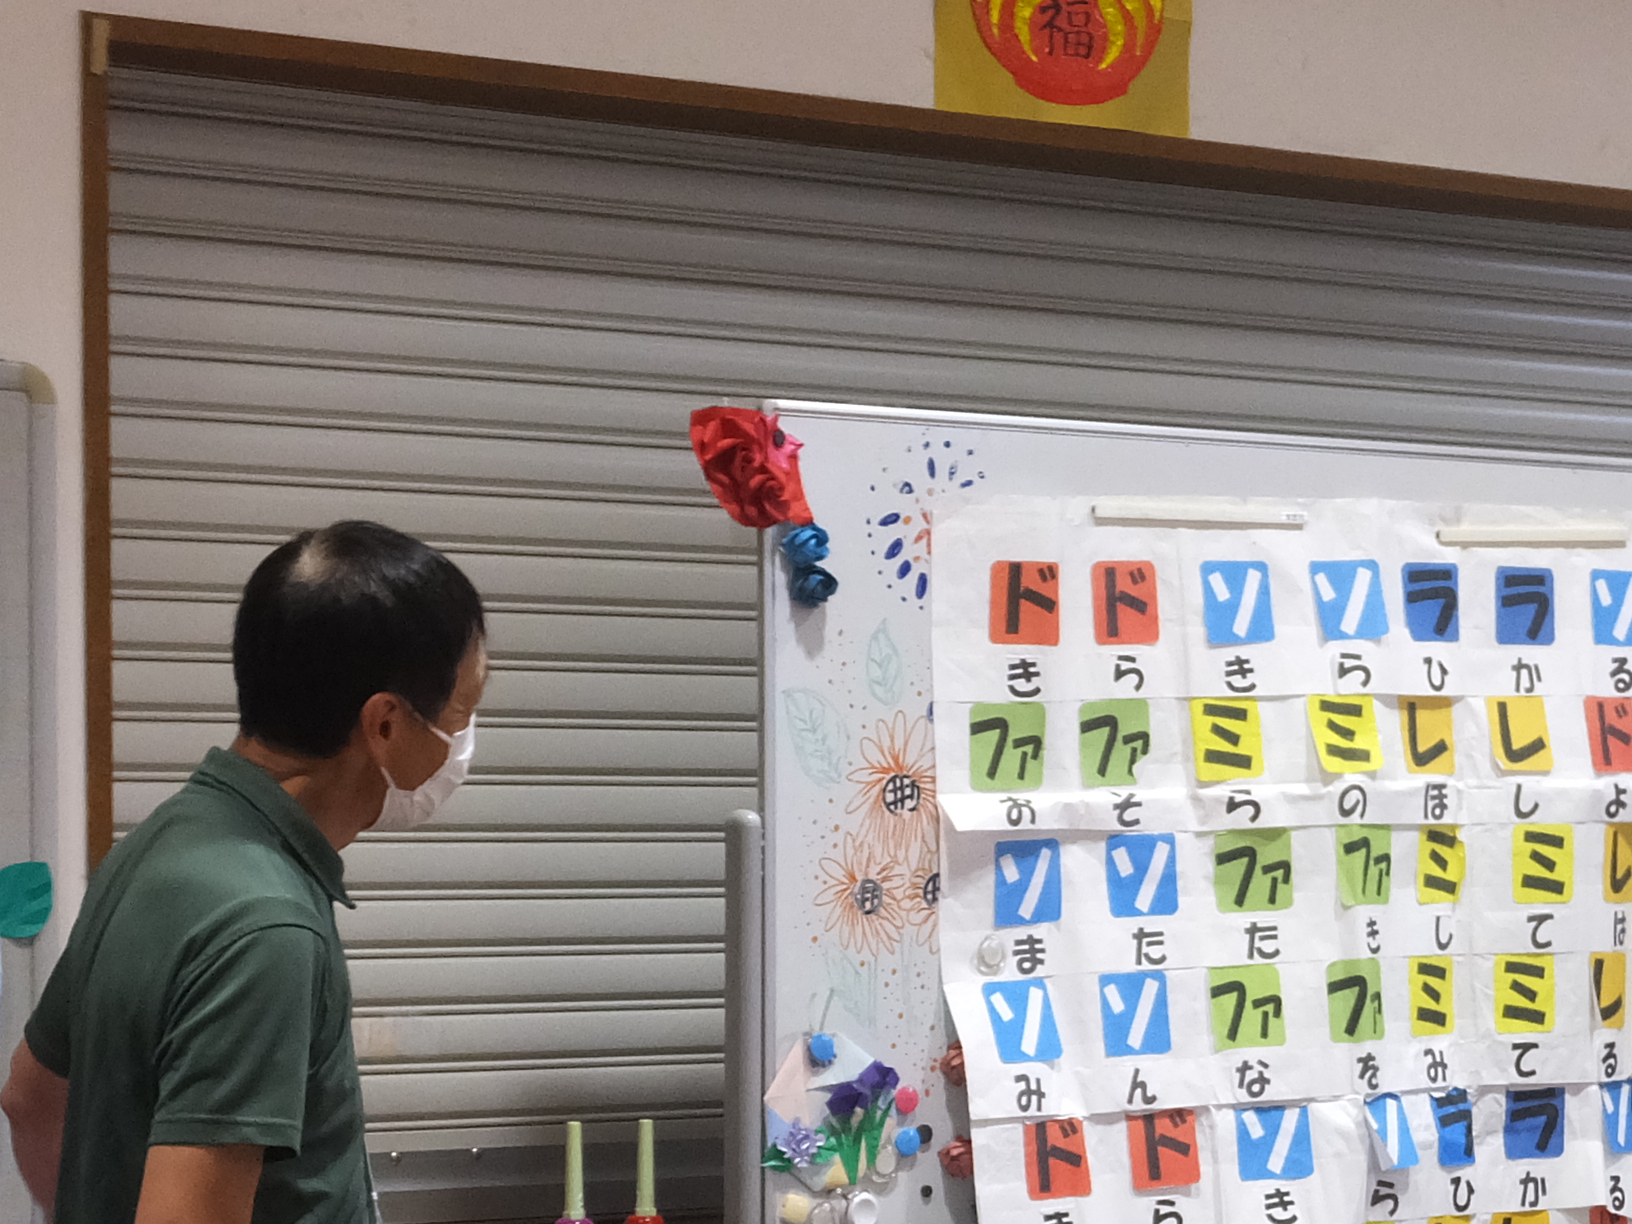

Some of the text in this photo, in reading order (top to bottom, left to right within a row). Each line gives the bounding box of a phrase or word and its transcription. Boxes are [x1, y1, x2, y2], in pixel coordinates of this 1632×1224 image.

[1040, 0, 1094, 59] 福
[1006, 562, 1056, 634] ド
[1105, 567, 1148, 637] ド
[1207, 568, 1262, 638] ソ
[1314, 567, 1372, 635] ソ
[1407, 570, 1457, 637] ラ
[1501, 574, 1549, 640] ラ
[1007, 659, 1041, 698] き
[1113, 655, 1144, 692] ら
[1224, 655, 1257, 694] き
[1338, 652, 1372, 688] ら
[1423, 656, 1449, 691] ひ
[1511, 657, 1542, 694] か
[970, 698, 1632, 781] ファ ファ ミ ミ レ レ ド
[1109, 791, 1143, 828] そ
[1226, 789, 1261, 823] ら
[1337, 783, 1368, 820] の
[1423, 783, 1449, 820] ほ
[1513, 783, 1540, 820] し
[1604, 782, 1628, 819] よ
[999, 829, 1632, 921] ソ ソ ファ ファ ミ ミ レ
[1012, 934, 1046, 974] ま
[1132, 927, 1167, 966] た
[1245, 922, 1280, 959] た
[1435, 916, 1453, 951] し
[1526, 914, 1554, 949] て
[989, 958, 1622, 1057] ソ ソ ファ ファ ミ ミ レ
[1014, 1042, 1617, 1112] み ん な を み て る
[1036, 1121, 1082, 1193] ド
[1143, 1113, 1191, 1180] ド
[1241, 1107, 1300, 1174] ソ
[1437, 1088, 1473, 1157] ラ
[1509, 1087, 1559, 1153] ラ
[1601, 1083, 1630, 1147] ソ
[1371, 1179, 1399, 1217] ら
[1450, 1176, 1475, 1212] ひ
[1519, 1171, 1546, 1208] か
[1609, 1175, 1625, 1211] る
